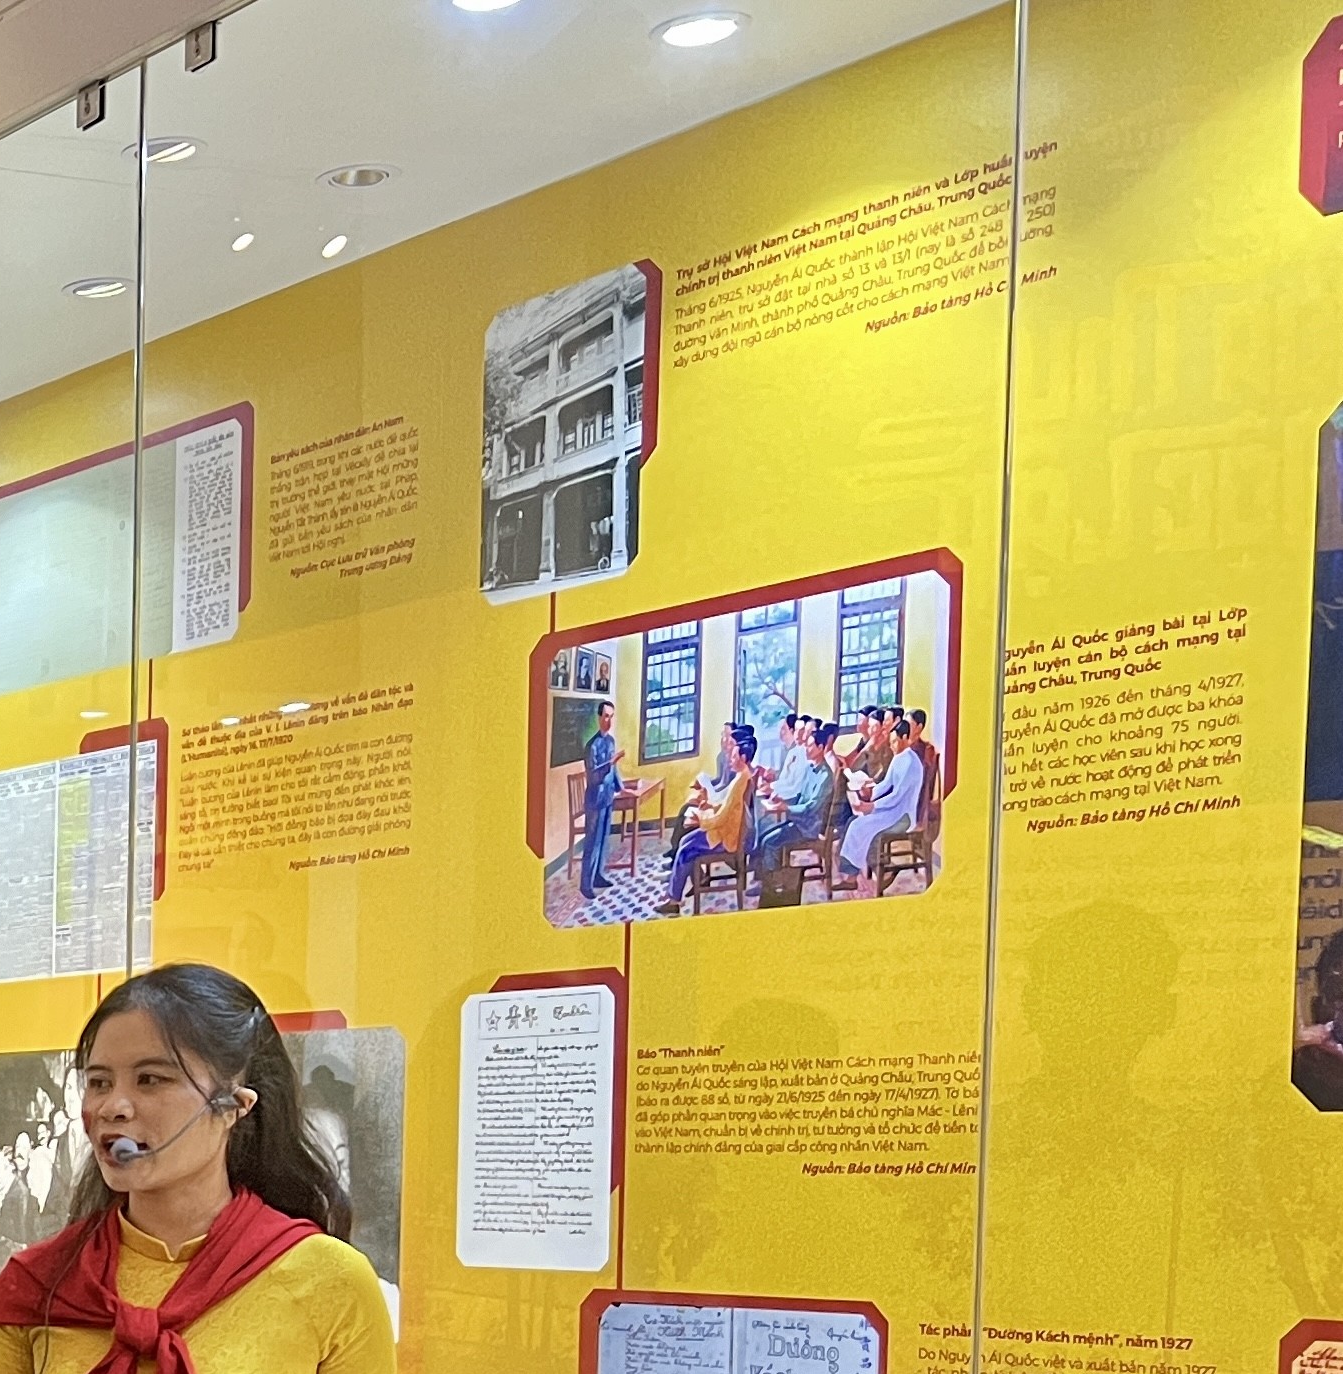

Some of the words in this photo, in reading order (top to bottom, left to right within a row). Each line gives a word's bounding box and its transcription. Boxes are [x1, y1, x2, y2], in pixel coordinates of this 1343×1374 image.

[1021, 141, 1059, 161] uyện
[1003, 639, 1046, 664] guyễn
[1049, 635, 1067, 651] Ái
[1070, 628, 1110, 649] Quốc
[1113, 623, 1156, 643] giảng
[1161, 614, 1186, 631] bài
[1191, 610, 1212, 629] tại
[1217, 606, 1249, 622] Lớp
[1032, 656, 1072, 673] luyện
[1076, 650, 1104, 665] cán
[1108, 644, 1129, 662] bộ
[1133, 638, 1170, 655] cách
[1175, 631, 1220, 649] mạng
[1225, 622, 1247, 642] tại
[1002, 680, 1037, 695] uảng
[1037, 673, 1079, 689] Châu,
[1078, 667, 1122, 683] Trung
[1122, 656, 1163, 677] Quốc
[1010, 705, 1038, 720] đầu
[1042, 701, 1075, 715] năm
[1079, 693, 1111, 710] 1926
[1115, 688, 1144, 704] đến
[1149, 683, 1192, 699] tháng
[1196, 672, 1245, 692] 4/1927,
[1001, 722, 1042, 742] guyễn
[1041, 719, 1058, 734] Ái
[1058, 713, 1097, 733] Quốc
[1097, 711, 1118, 725] đã
[1118, 706, 1146, 723] mở
[1145, 703, 1184, 719] được
[1185, 699, 1206, 713] ba
[1207, 693, 1244, 709] khóa
[1030, 737, 1069, 756] luyện
[1074, 733, 1103, 747] cho
[1108, 724, 1164, 743] khoảng
[1169, 719, 1190, 734] 75
[1196, 712, 1241, 732] người.
[1020, 757, 1045, 773] hết
[1046, 755, 1071, 769] các
[1071, 753, 1098, 767] học
[1098, 747, 1128, 763] viên
[1128, 746, 1153, 759] sau
[1154, 739, 1177, 755] khi
[1178, 738, 1206, 753] học
[1206, 730, 1243, 749] xong
[1028, 794, 1054, 808] trào
[1053, 790, 1087, 805] cách
[1088, 786, 1131, 801] mạng
[1132, 780, 1151, 797] tại
[1152, 777, 1182, 793] Việt
[1183, 774, 1224, 789] Nam.
[1078, 809, 1110, 826] Bảo
[1110, 807, 1148, 822] tàng
[1146, 800, 1172, 818] Hồ
[1172, 798, 1203, 815] Chí
[1200, 794, 1242, 812] Minh
[952, 1161, 978, 1174] Min
